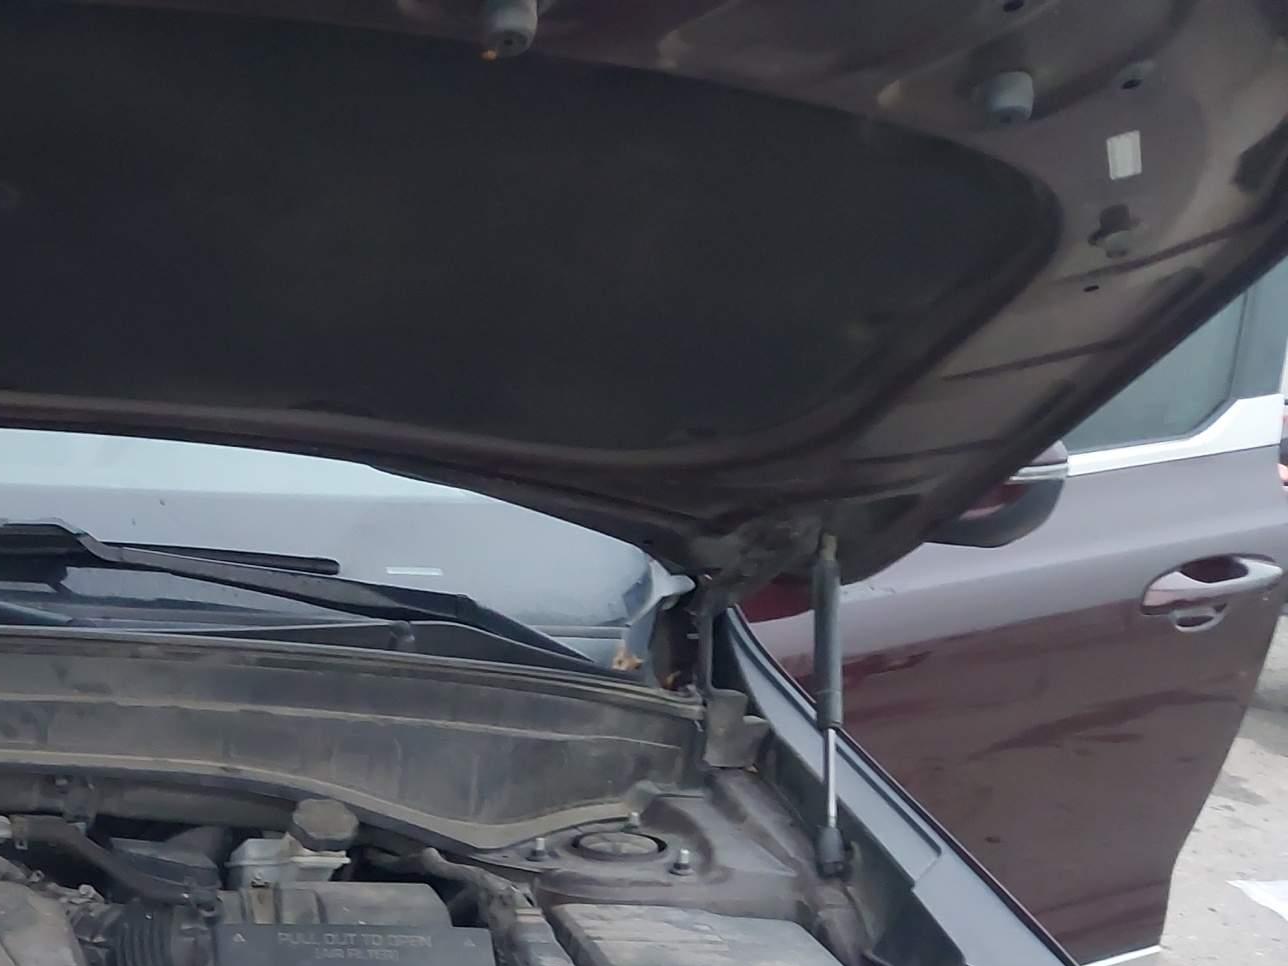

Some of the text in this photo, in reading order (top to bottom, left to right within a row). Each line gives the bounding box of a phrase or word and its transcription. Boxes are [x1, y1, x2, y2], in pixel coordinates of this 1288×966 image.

[278, 932, 432, 948] PULL OUT TO OPEN
